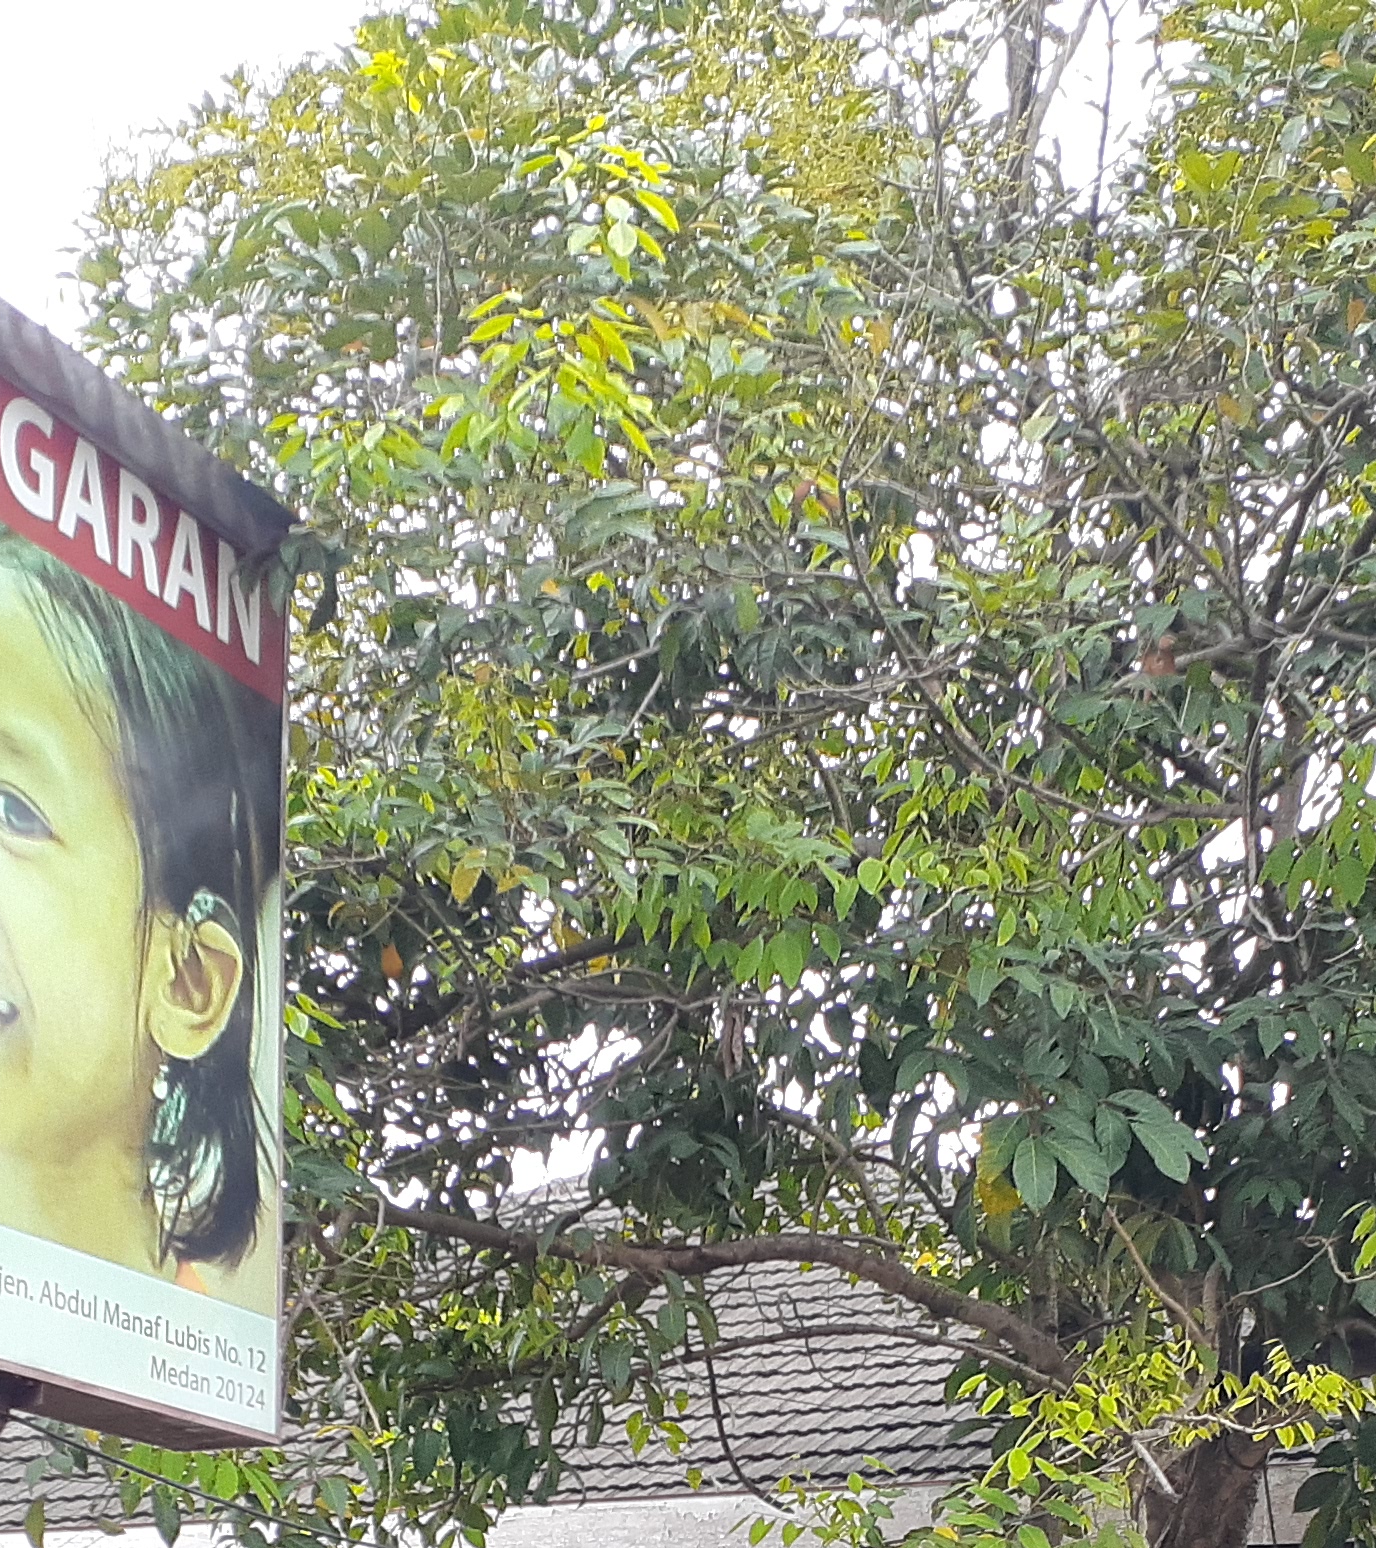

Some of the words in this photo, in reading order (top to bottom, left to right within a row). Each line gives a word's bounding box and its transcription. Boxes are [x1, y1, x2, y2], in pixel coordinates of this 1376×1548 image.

[39, 1280, 98, 1321] Abdul
[103, 1300, 163, 1340] Manaf
[165, 1320, 211, 1356] Lubis
[215, 1334, 243, 1367] No.
[247, 1347, 267, 1374] 12
[150, 1355, 211, 1396] Medan
[215, 1375, 267, 1411] 20124
